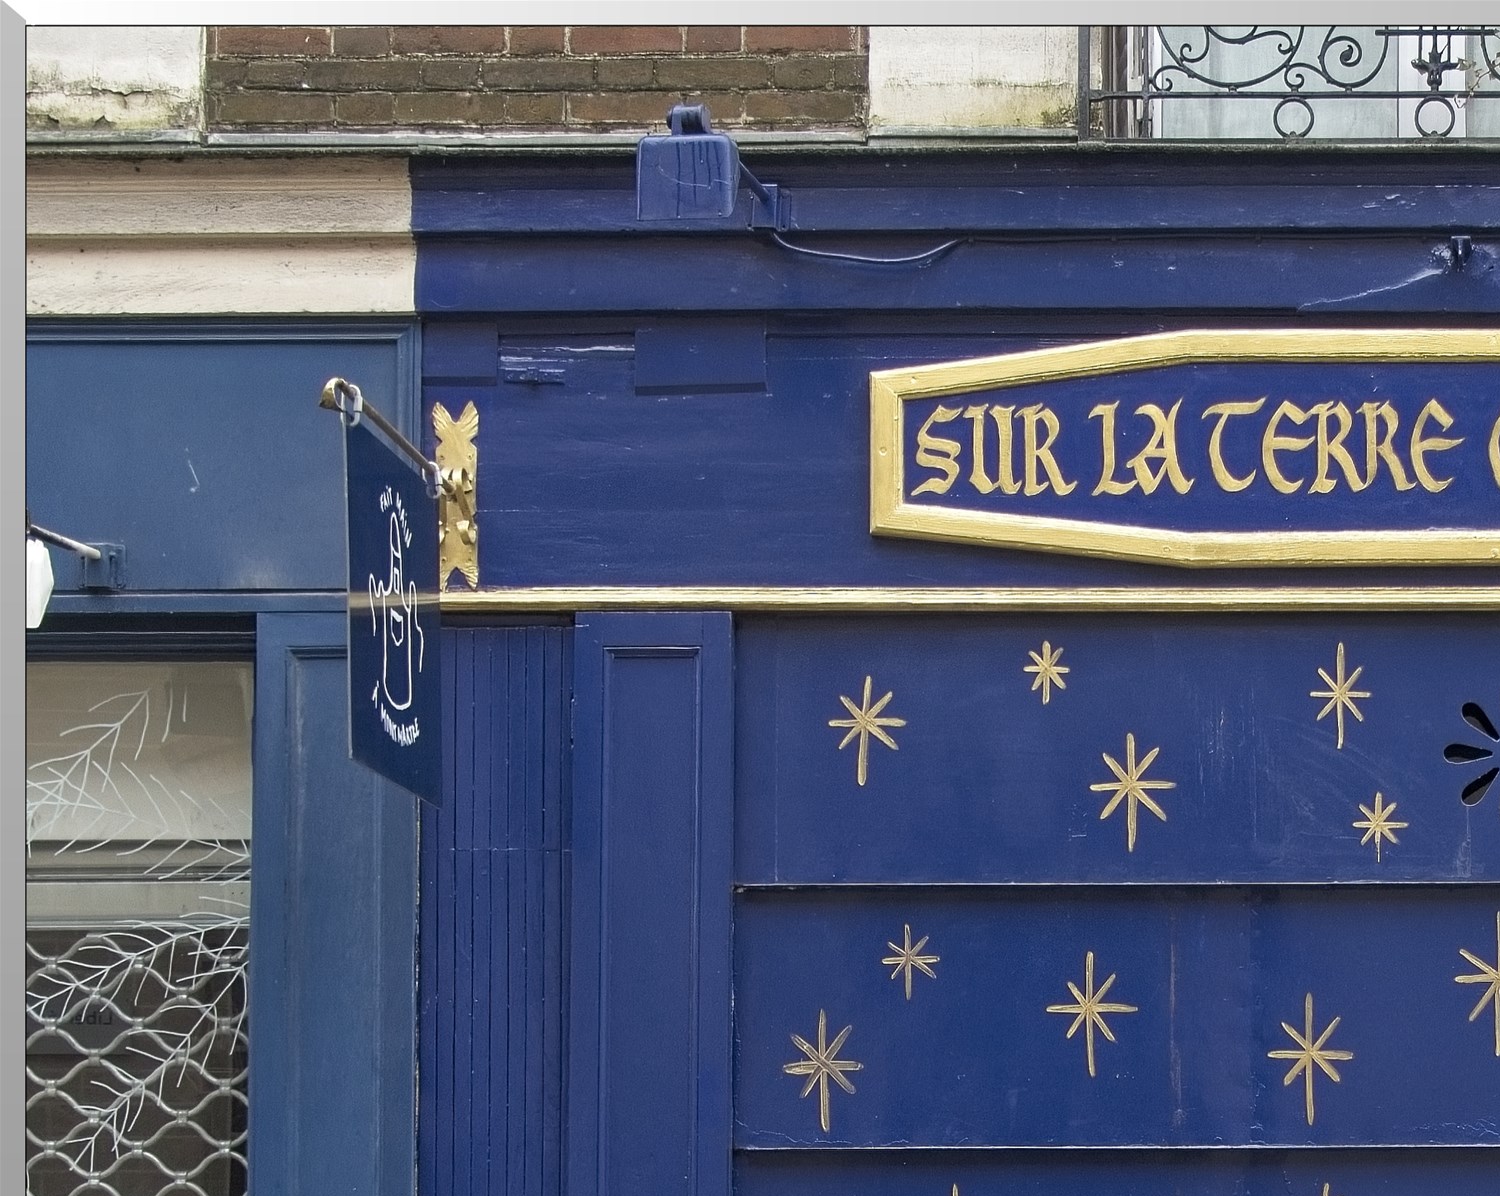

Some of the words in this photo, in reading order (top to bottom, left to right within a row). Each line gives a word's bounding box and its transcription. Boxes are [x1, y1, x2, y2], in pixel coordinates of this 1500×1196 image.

[910, 402, 1078, 496] SUR
[1089, 397, 1196, 496] LA
[1201, 397, 1465, 495] TERRE
